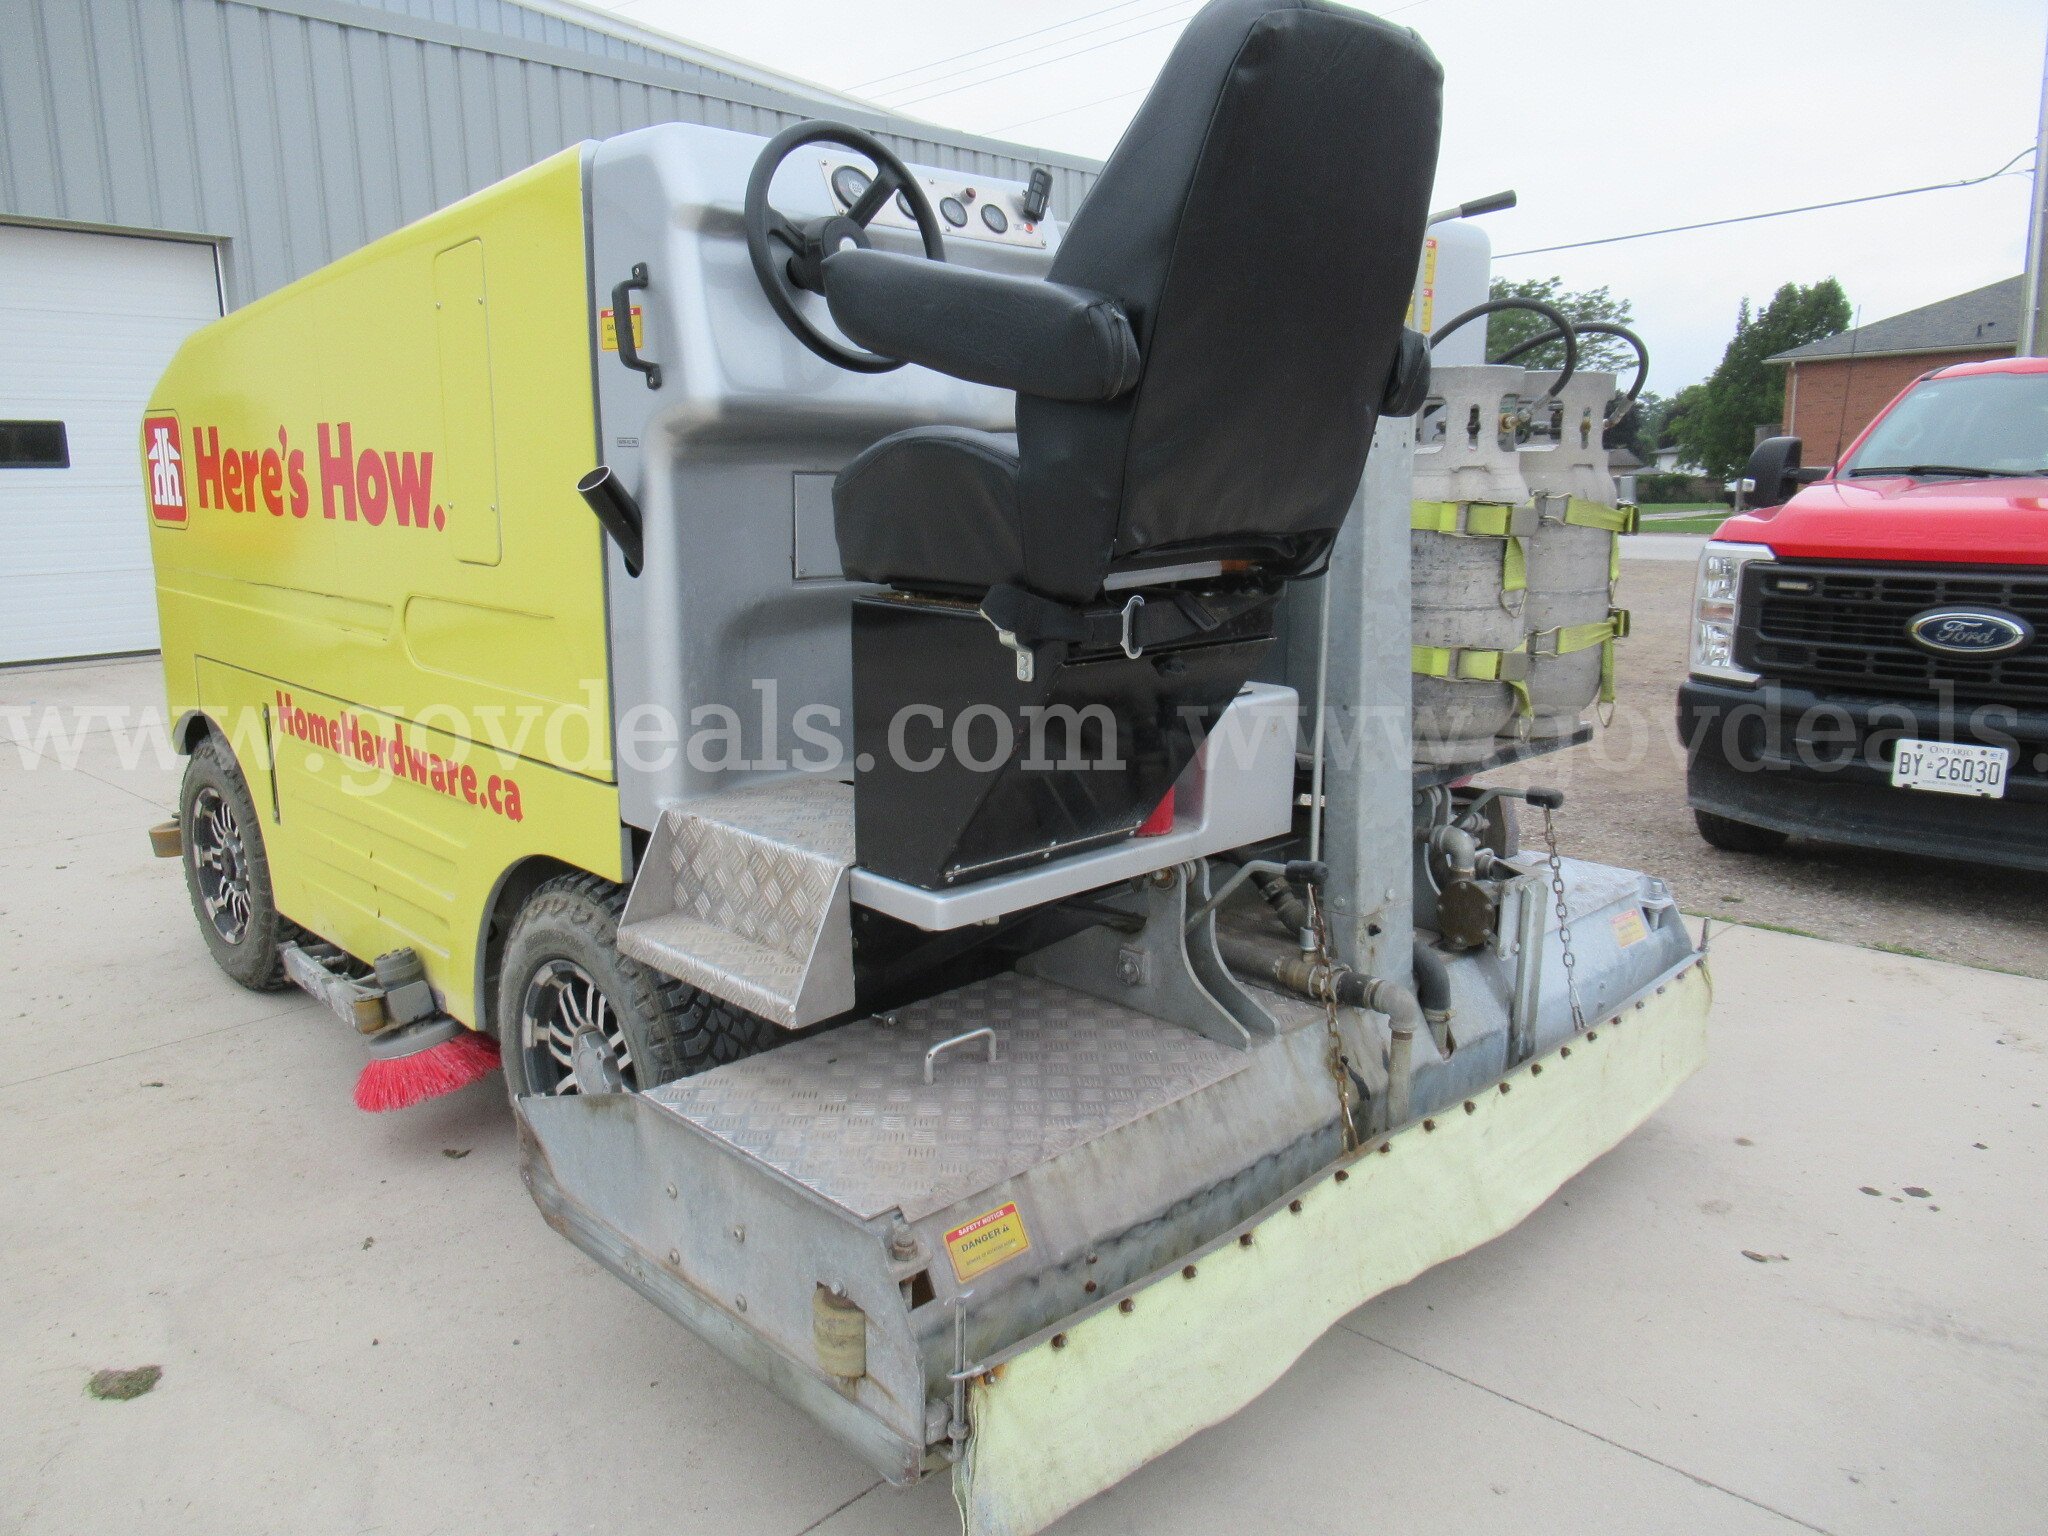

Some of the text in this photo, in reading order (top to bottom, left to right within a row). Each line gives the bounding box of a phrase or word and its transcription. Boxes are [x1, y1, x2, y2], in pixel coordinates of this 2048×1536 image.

[193, 422, 446, 532] Here's How.
[1936, 620, 1997, 643] Ford
[276, 689, 523, 823] HomeHardware.ca
[1929, 745, 1974, 757] ONTARIO
[1898, 751, 2001, 786] BY 26030
[958, 1209, 1005, 1236] SAFETY NOTICE
[961, 1228, 1001, 1253] DANGER
